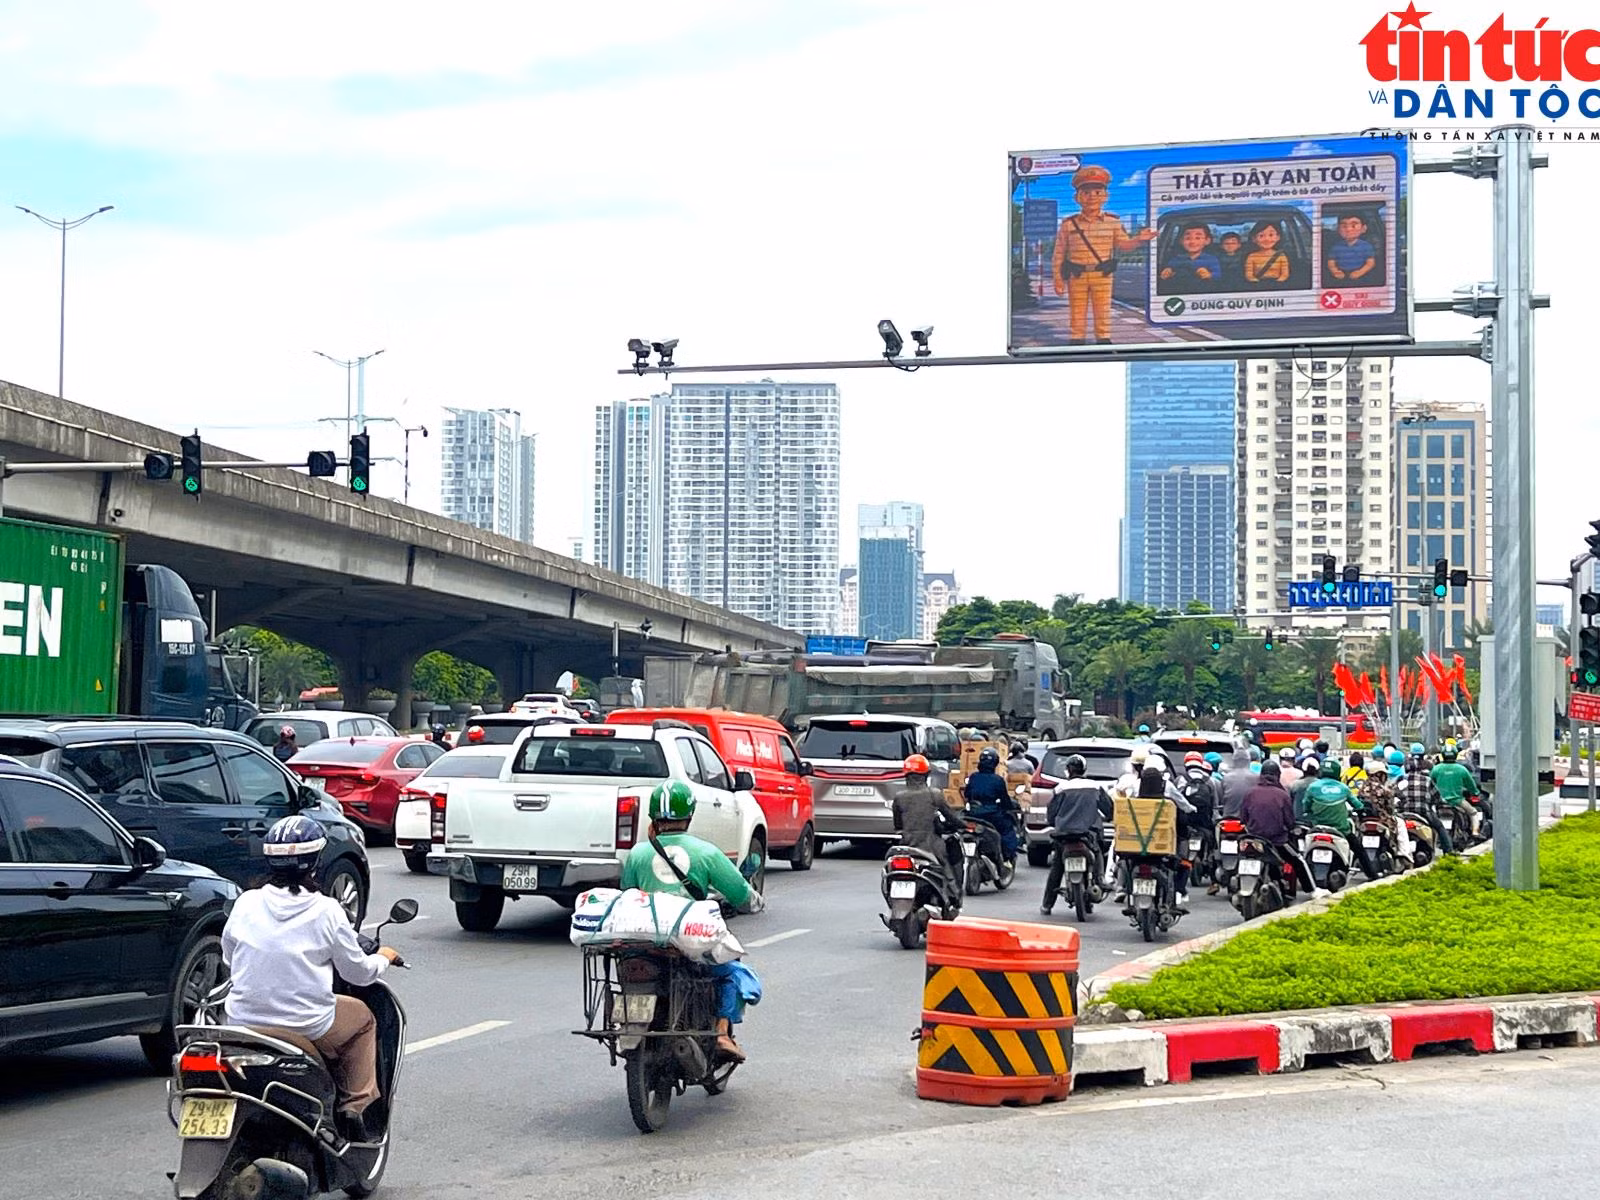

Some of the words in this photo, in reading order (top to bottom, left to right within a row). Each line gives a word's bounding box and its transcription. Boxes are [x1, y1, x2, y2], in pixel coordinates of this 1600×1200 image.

[1172, 168, 1225, 189] THẮT
[1232, 167, 1274, 187] DÂY
[1280, 168, 1310, 185] AN
[1318, 162, 1376, 182] TOÀN
[1191, 299, 1224, 310] ĐÚNG
[1227, 299, 1252, 309] QUY
[1255, 298, 1284, 310] ĐỊNH
[511, 865, 530, 876] 29H
[504, 876, 537, 889] 050.99
[181, 1118, 229, 1136] 254.33
